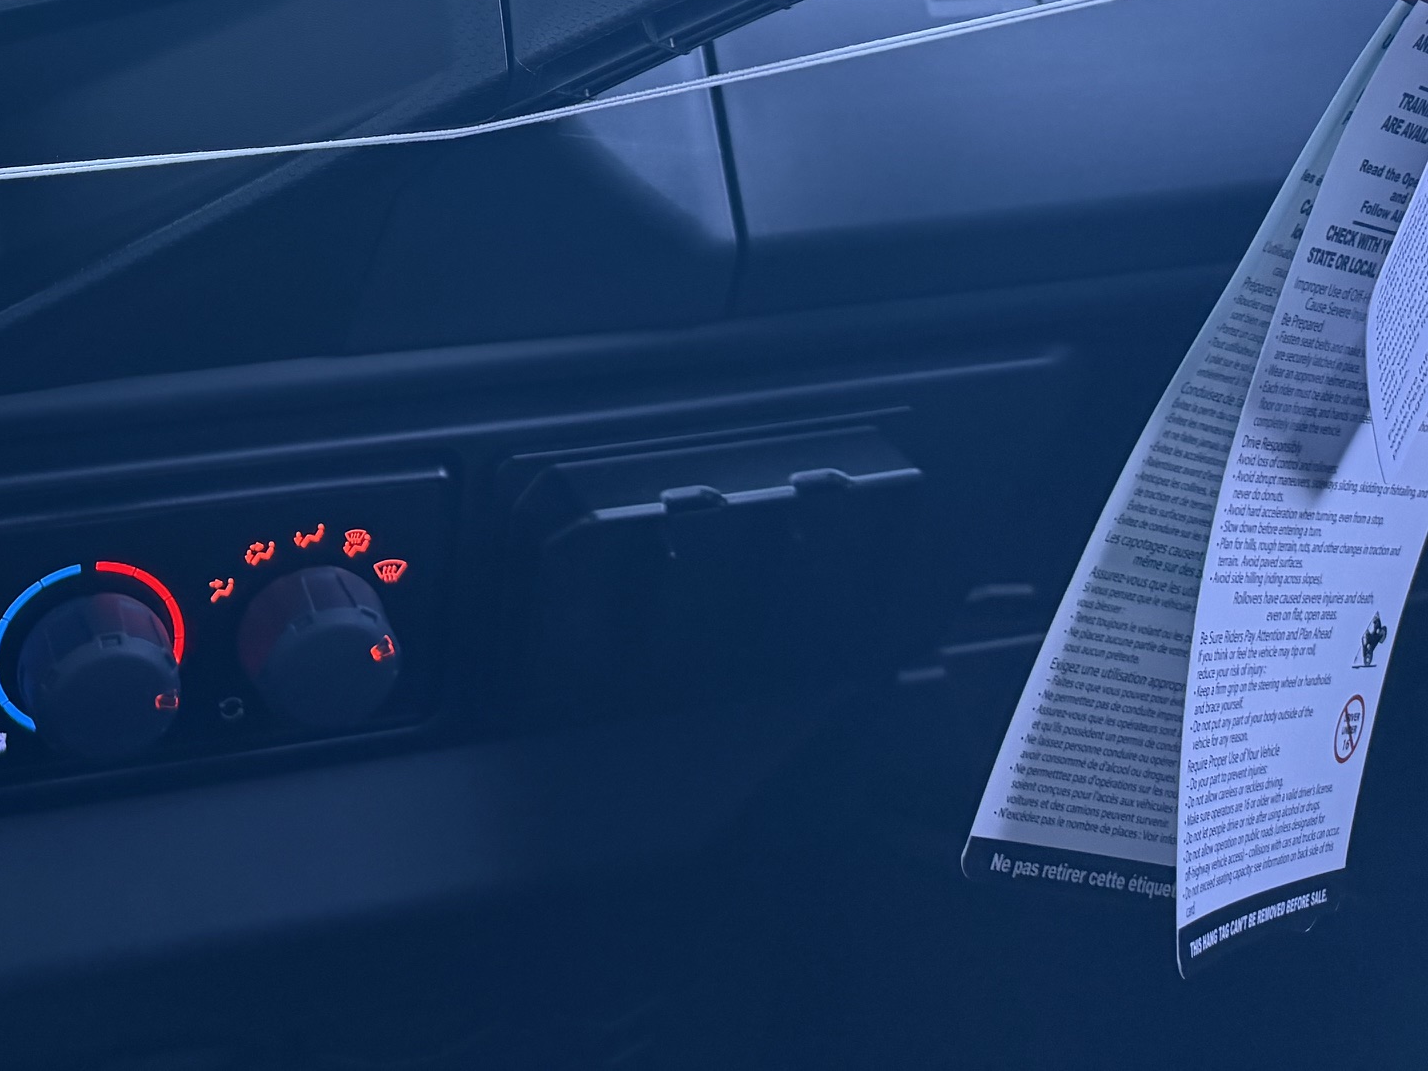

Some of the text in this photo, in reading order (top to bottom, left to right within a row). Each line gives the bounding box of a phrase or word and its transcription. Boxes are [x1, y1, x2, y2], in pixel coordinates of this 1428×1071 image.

[1381, 115, 1405, 135] ARE
[1359, 159, 1386, 178] Read
[1387, 168, 1401, 183] the
[1360, 200, 1389, 219] Follow
[1390, 191, 1409, 204] and
[1326, 225, 1359, 247] CHECK
[1357, 233, 1382, 253] WITH
[1307, 247, 1378, 278] STATE OR LOCAL
[1200, 626, 1333, 645] Be Sure Riders Pay Attention and Plan Ahead
[1187, 743, 1281, 775] Require Proper Use of Your Vehicle
[990, 852, 1011, 872] Ne
[1012, 861, 1040, 878] pas
[1042, 863, 1087, 883] retirer
[1088, 871, 1125, 889] cette
[1190, 889, 1327, 958] THIS HANG TAG CAN'T BE REMOVED BEFORE SALE.
